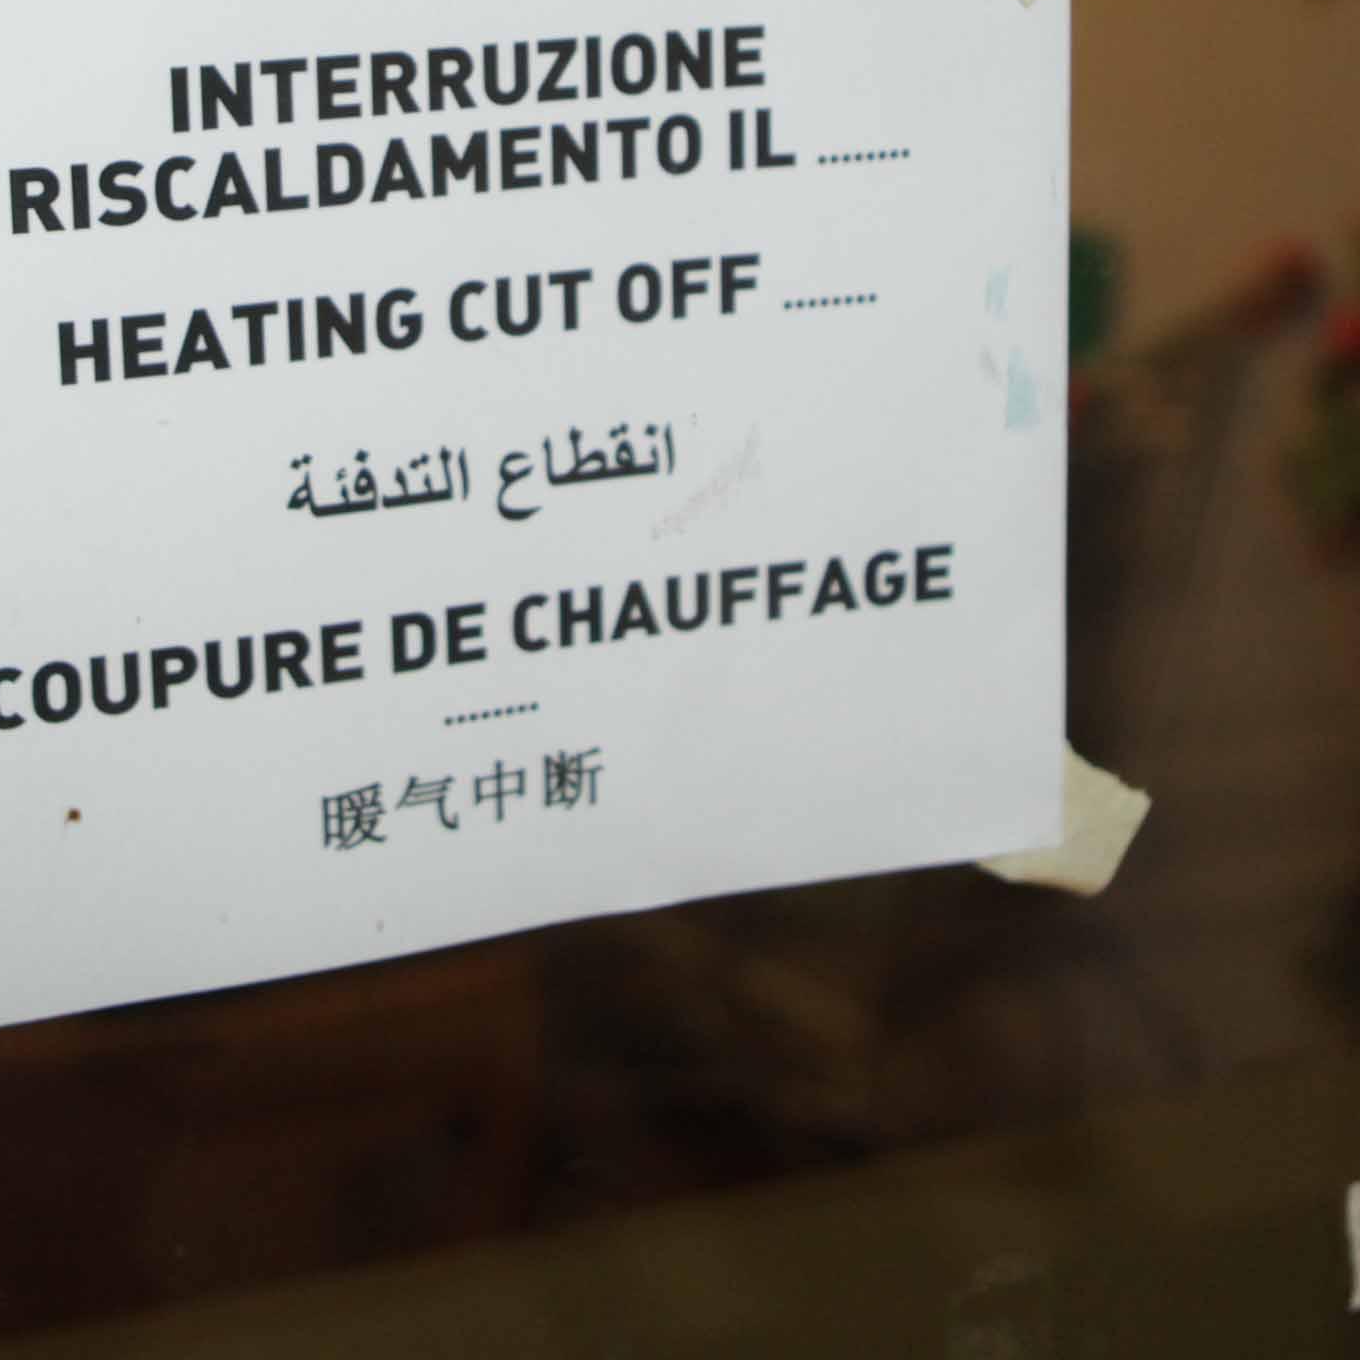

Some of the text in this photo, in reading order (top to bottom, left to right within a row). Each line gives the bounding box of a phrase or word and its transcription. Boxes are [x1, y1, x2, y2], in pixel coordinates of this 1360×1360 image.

[169, 24, 766, 133] INTERRUZIONE
[8, 113, 702, 235] RISCALDAMENTO
[728, 108, 797, 171] IL
[57, 286, 424, 386] HEATING
[448, 269, 593, 343] CUT
[616, 252, 761, 324] OFF
[286, 421, 676, 521] انقطاع التدفئة
[391, 602, 488, 675] DE
[512, 543, 955, 654] CHAUFFAGE
[319, 746, 604, 852] 暖气中断
